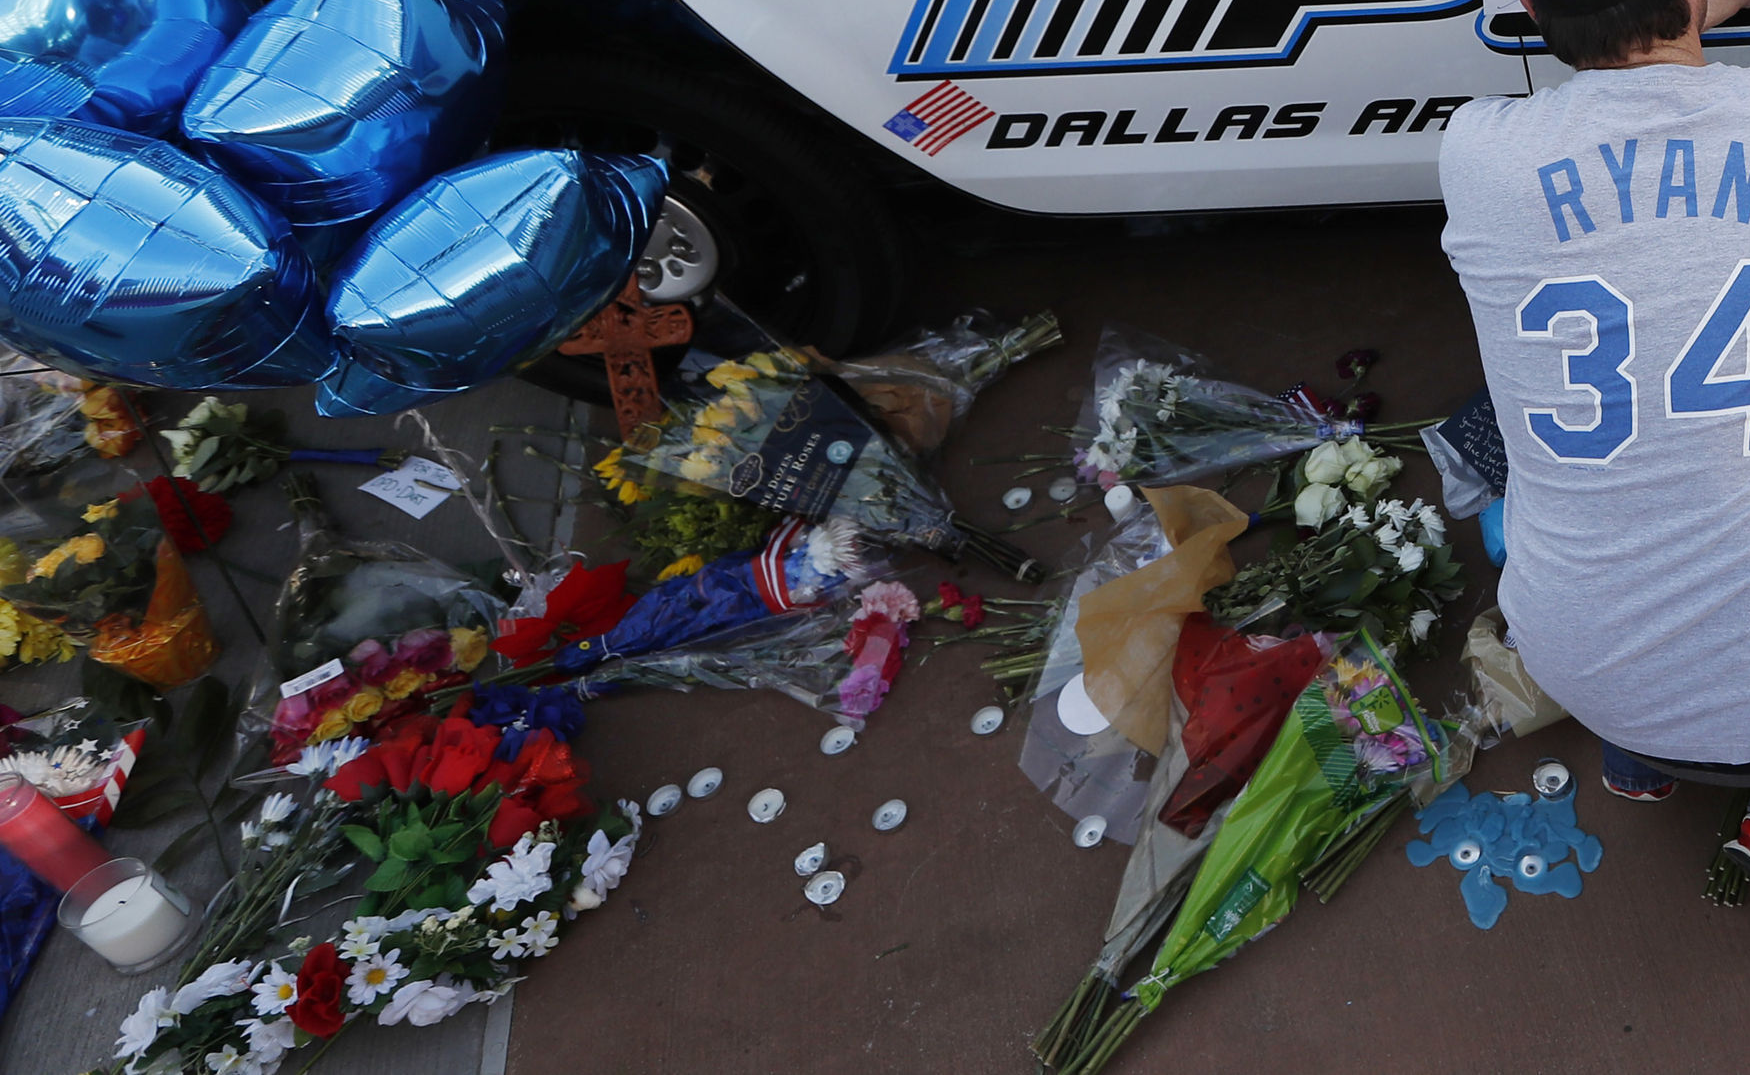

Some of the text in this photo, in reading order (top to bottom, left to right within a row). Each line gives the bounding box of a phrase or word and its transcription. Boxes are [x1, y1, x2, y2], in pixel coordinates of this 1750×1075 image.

[985, 102, 1327, 150] DALLAS
[768, 453, 794, 489] DOZEN
[772, 475, 798, 513] TURE
[791, 433, 821, 472] ROSES
